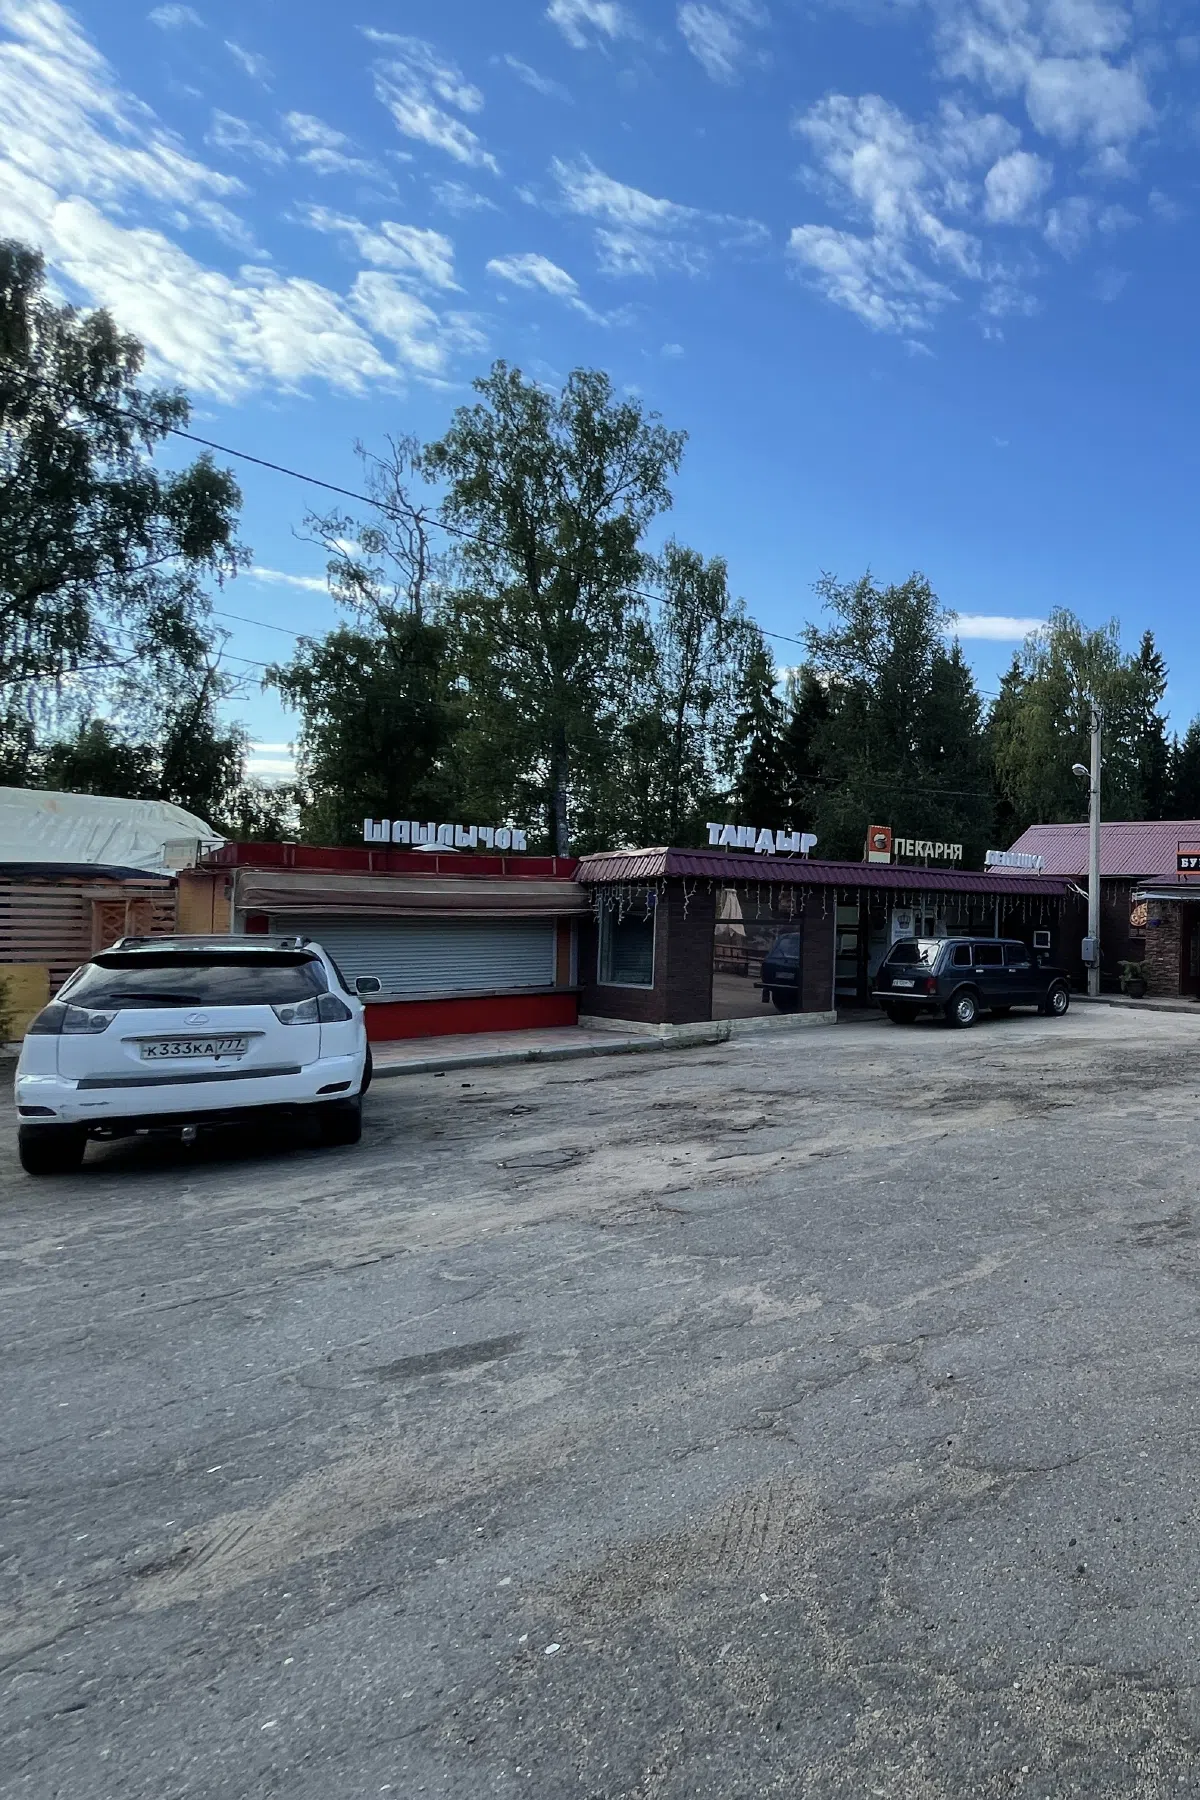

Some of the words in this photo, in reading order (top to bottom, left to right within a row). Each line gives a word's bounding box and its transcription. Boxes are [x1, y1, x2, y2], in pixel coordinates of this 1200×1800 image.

[364, 818, 526, 850] ШАШЛЫЧОК
[706, 822, 818, 854] ТАНДЫР
[894, 838, 963, 860] ПЕКАРНЯ
[219, 1039, 242, 1050] 777
